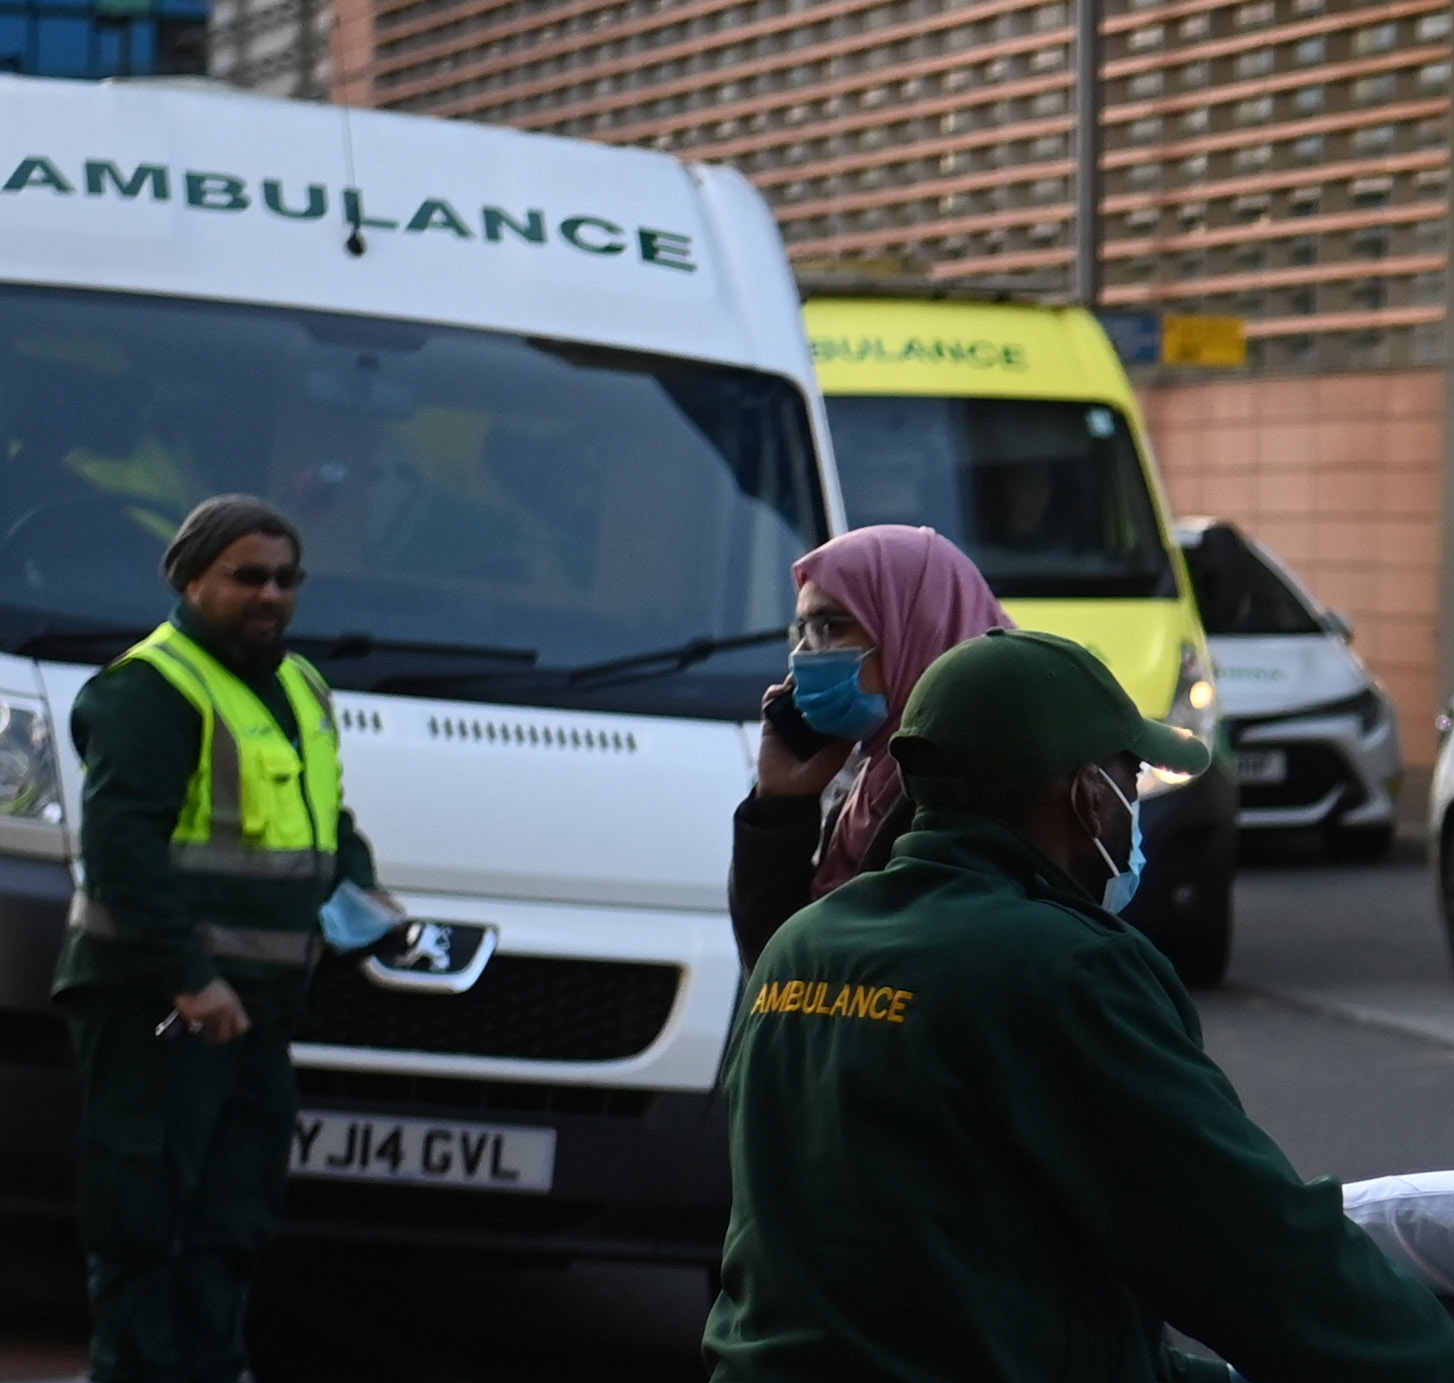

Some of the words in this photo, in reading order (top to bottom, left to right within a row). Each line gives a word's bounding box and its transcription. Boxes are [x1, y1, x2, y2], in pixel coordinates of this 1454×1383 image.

[2, 156, 698, 273] AMBULANCE
[751, 979, 914, 1023] AMBULANCE
[296, 1119, 405, 1171] YJ14
[422, 1128, 521, 1182] GVL
